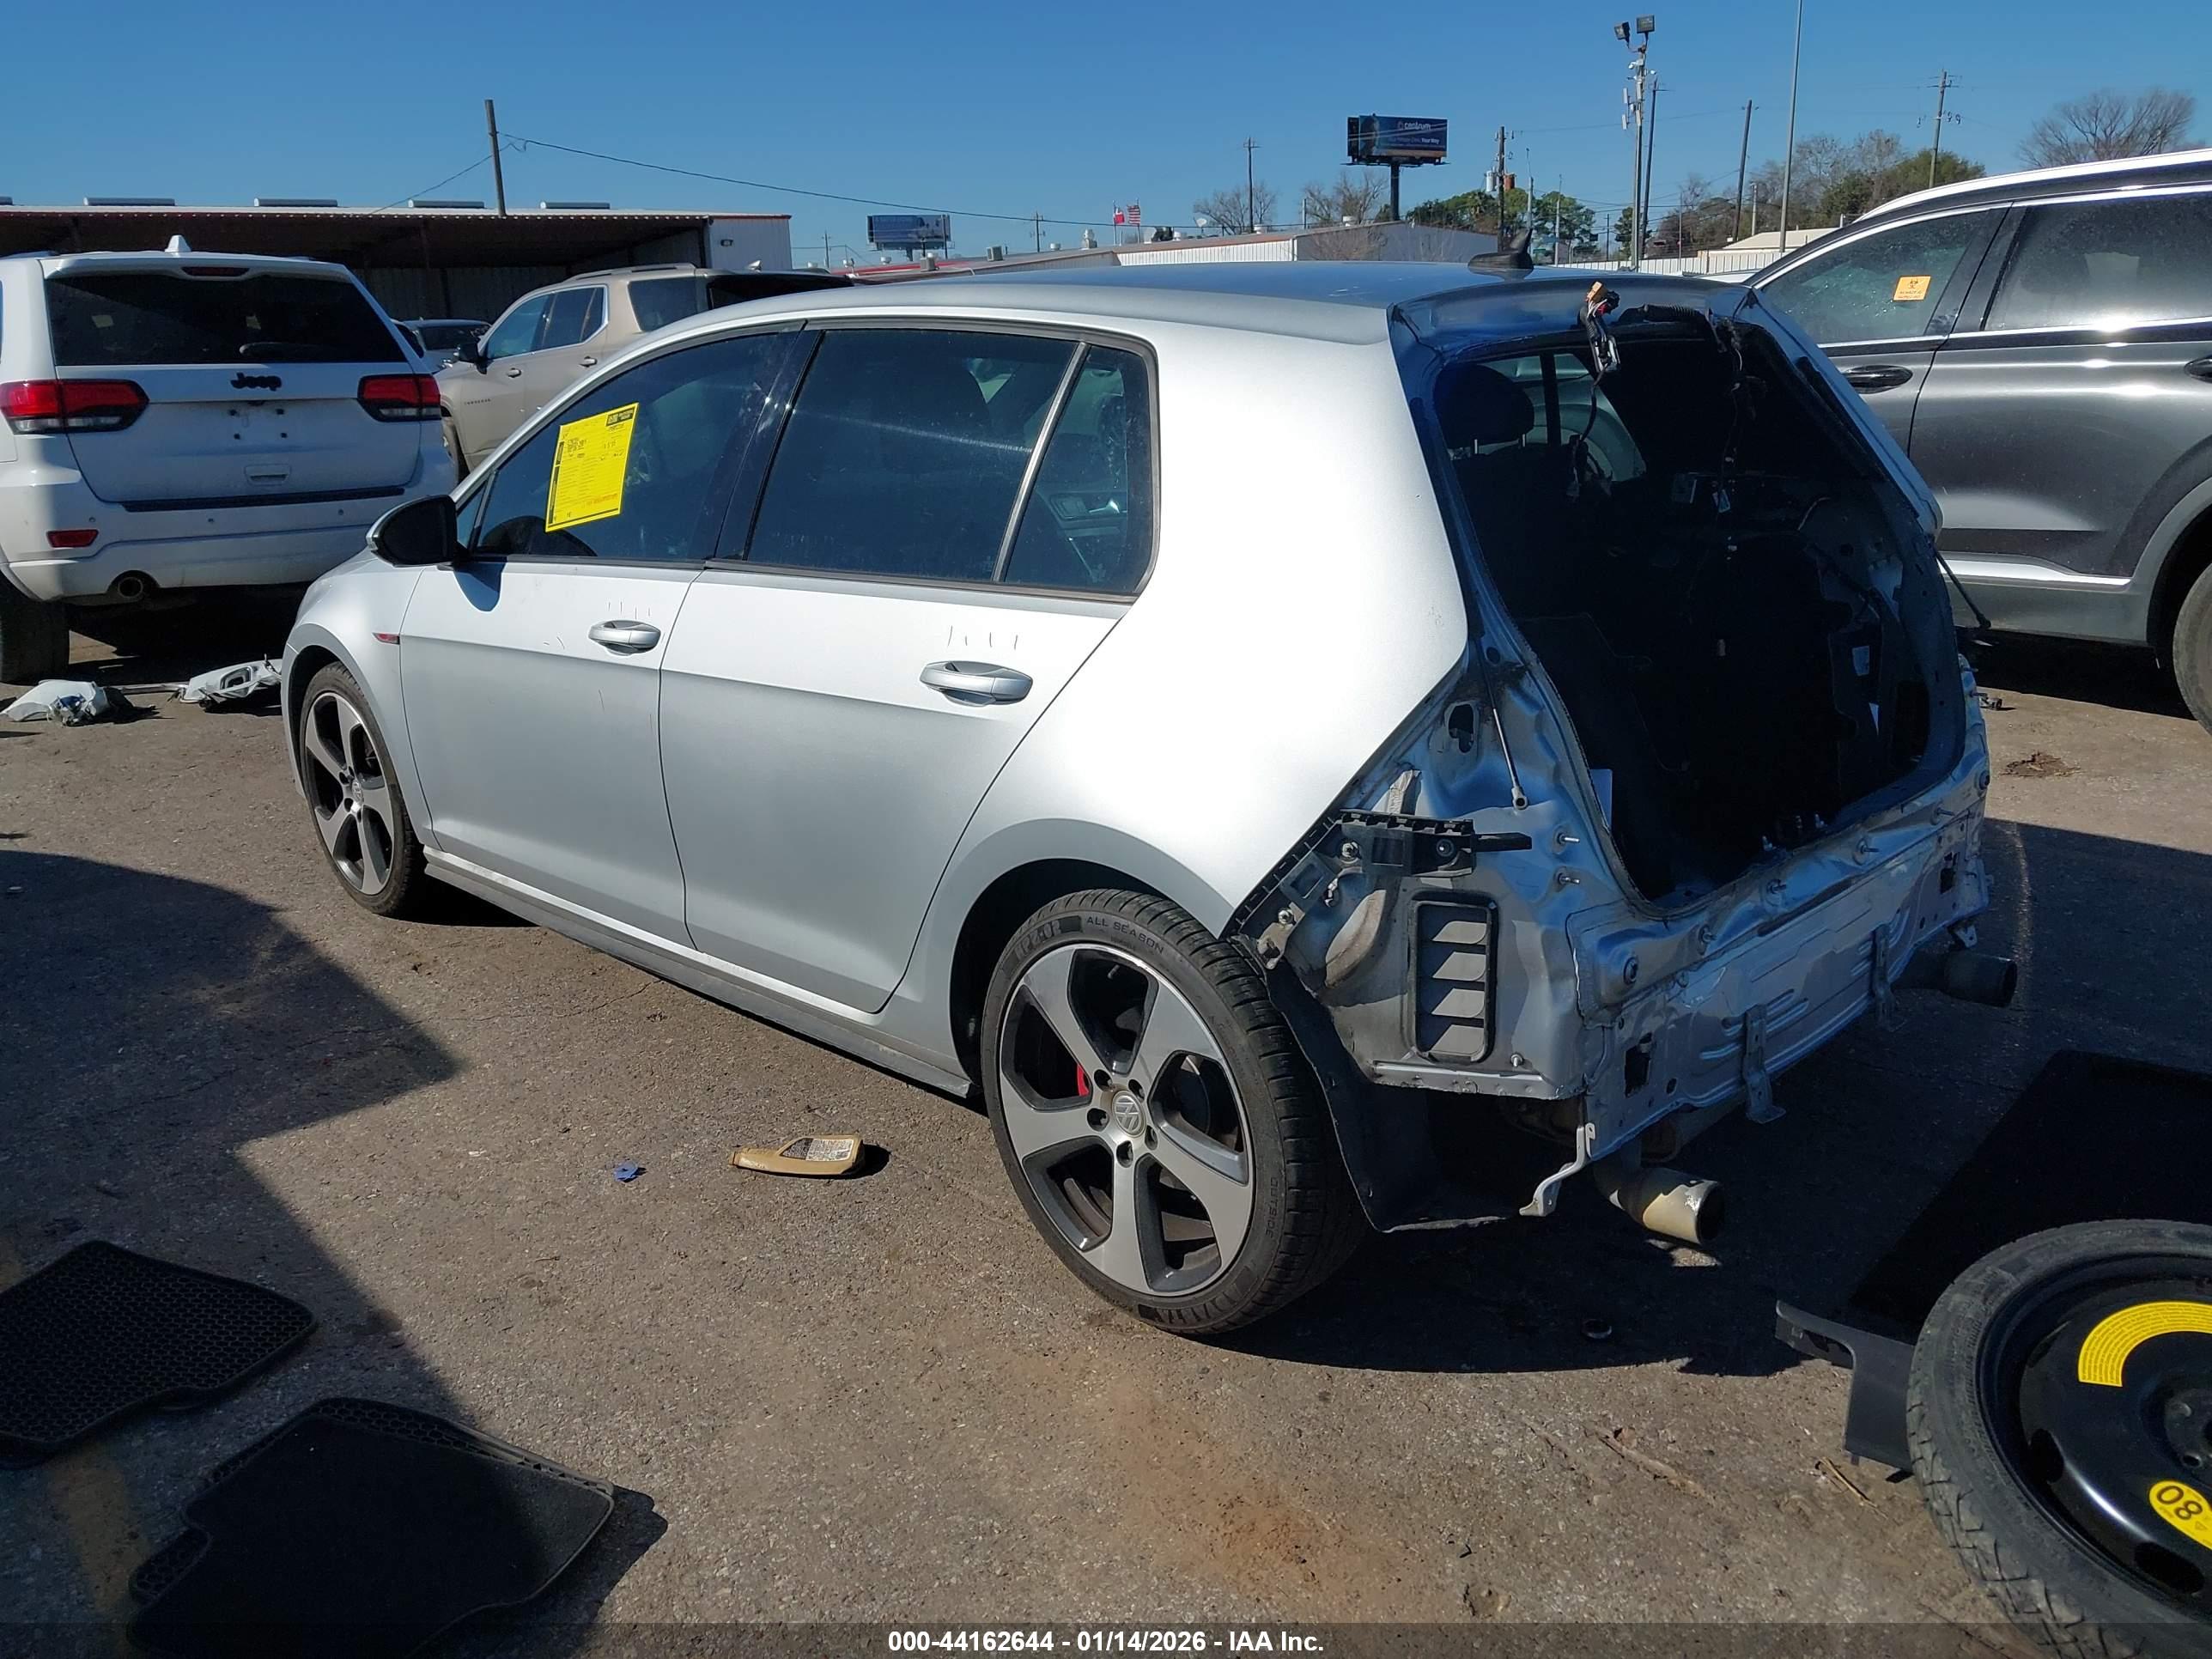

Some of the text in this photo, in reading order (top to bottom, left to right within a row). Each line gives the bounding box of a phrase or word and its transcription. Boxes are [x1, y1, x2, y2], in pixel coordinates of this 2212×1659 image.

[231, 373, 282, 392] Jeep
[1085, 915, 1109, 928] ALL
[1113, 922, 1165, 956] SEASON
[1265, 1176, 1280, 1238] OUTSIDE
